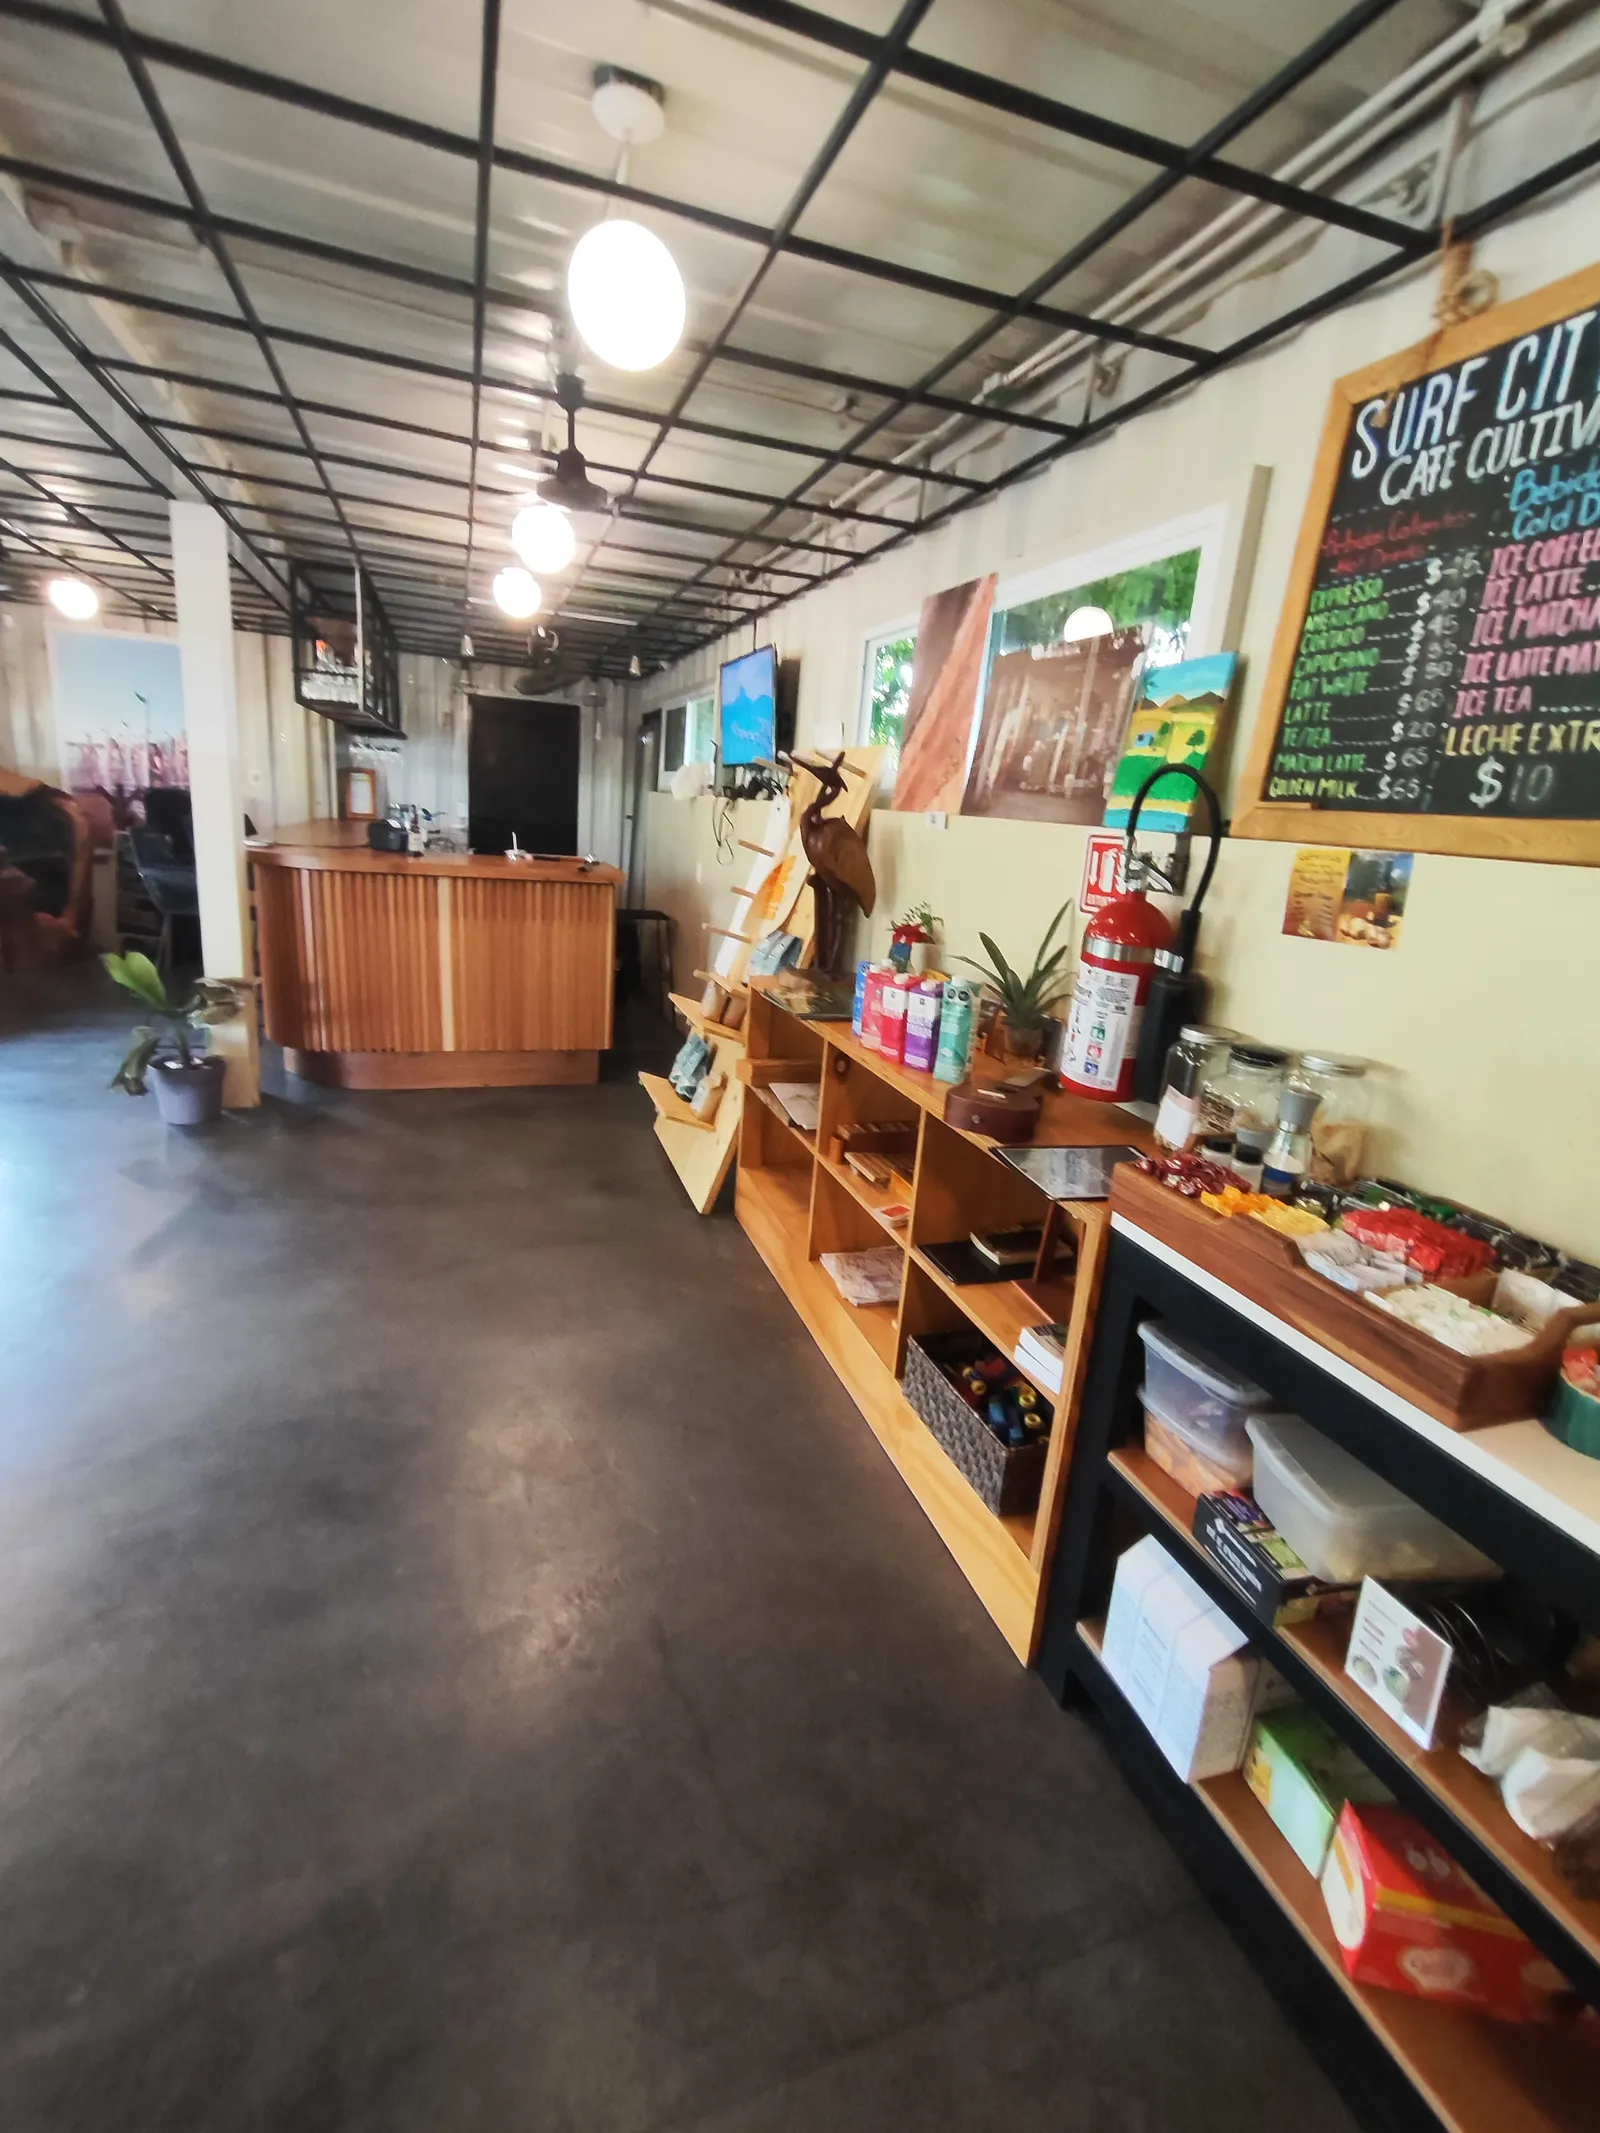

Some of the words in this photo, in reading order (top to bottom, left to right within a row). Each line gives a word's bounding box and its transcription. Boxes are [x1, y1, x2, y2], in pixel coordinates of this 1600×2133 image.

[1351, 356, 1489, 480] SURF
[1495, 309, 1600, 421] CIT
[1512, 499, 1575, 540] Cold
[1487, 543, 1526, 580] ICE
[1478, 576, 1515, 610] ICE
[1513, 566, 1588, 606] LATTE
[1468, 609, 1510, 648] ICE
[1460, 651, 1496, 685] ICE
[1495, 646, 1556, 682] LATTE
[1283, 701, 1333, 725] LATTE
[1451, 689, 1489, 720] ICE
[1493, 684, 1534, 716] TEA
[1444, 720, 1526, 758] LECHE
[1316, 777, 1359, 799] MILK
